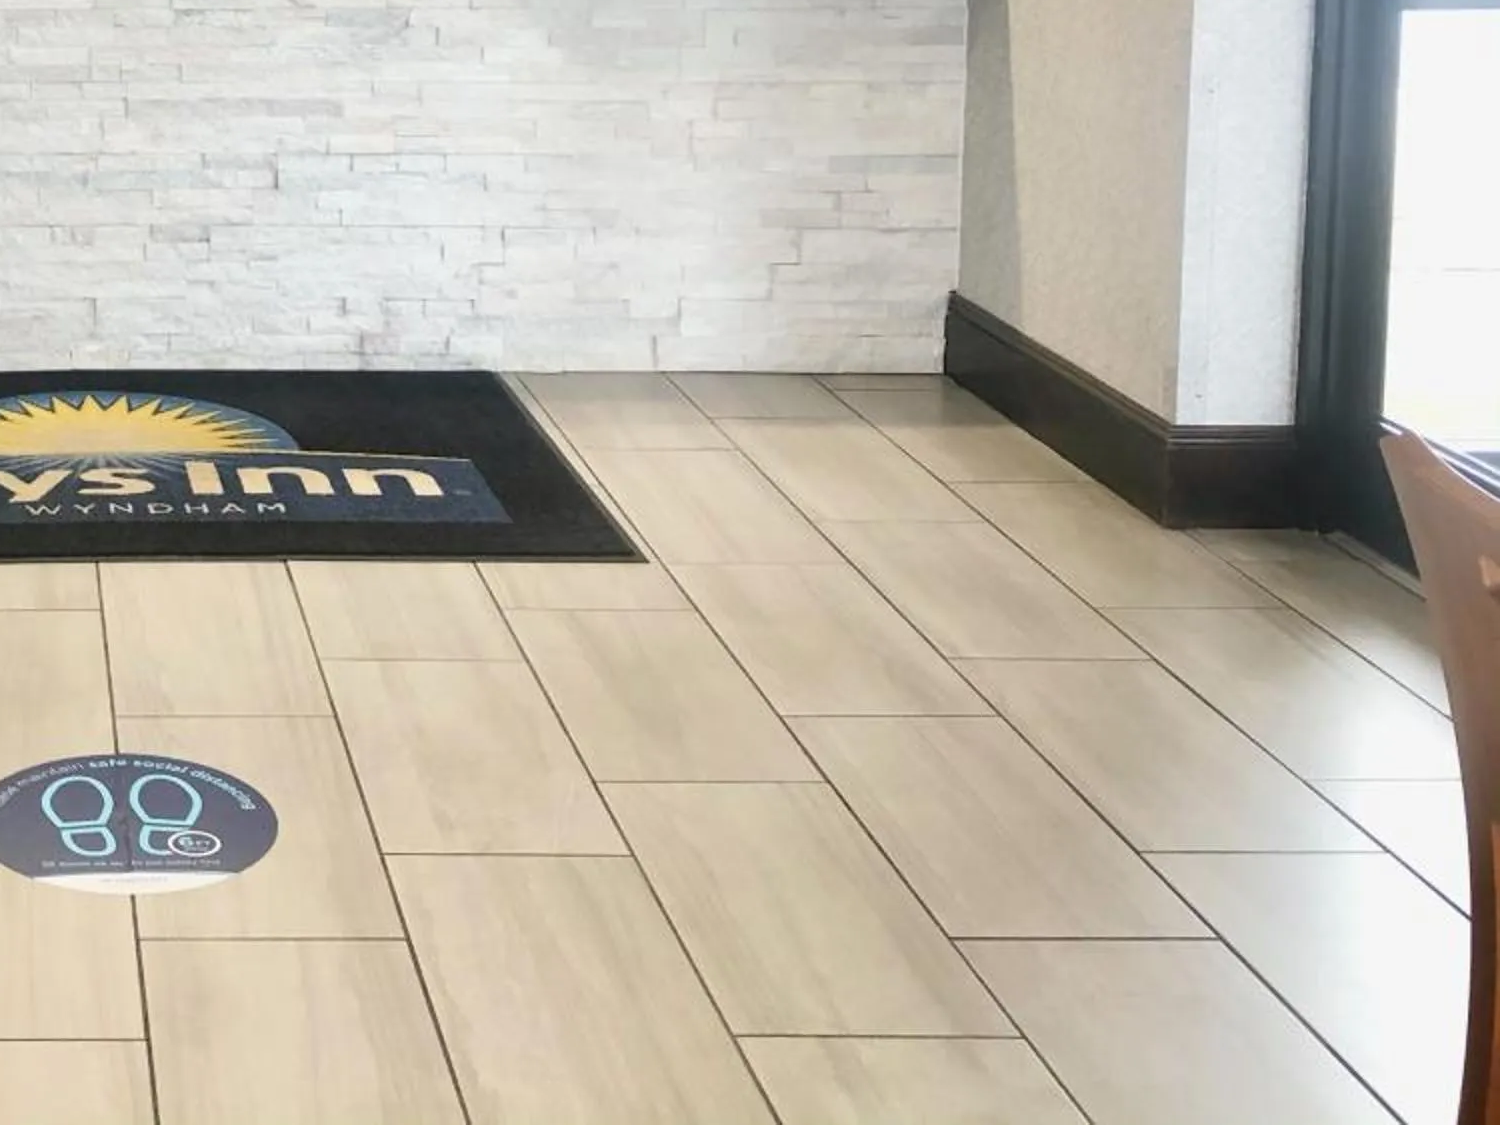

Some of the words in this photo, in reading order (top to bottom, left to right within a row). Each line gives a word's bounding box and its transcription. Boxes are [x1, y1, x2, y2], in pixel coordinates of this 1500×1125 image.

[187, 459, 446, 497] Inn
[24, 501, 289, 518] WYNDHAM
[88, 758, 128, 769] safe
[133, 759, 190, 775] social
